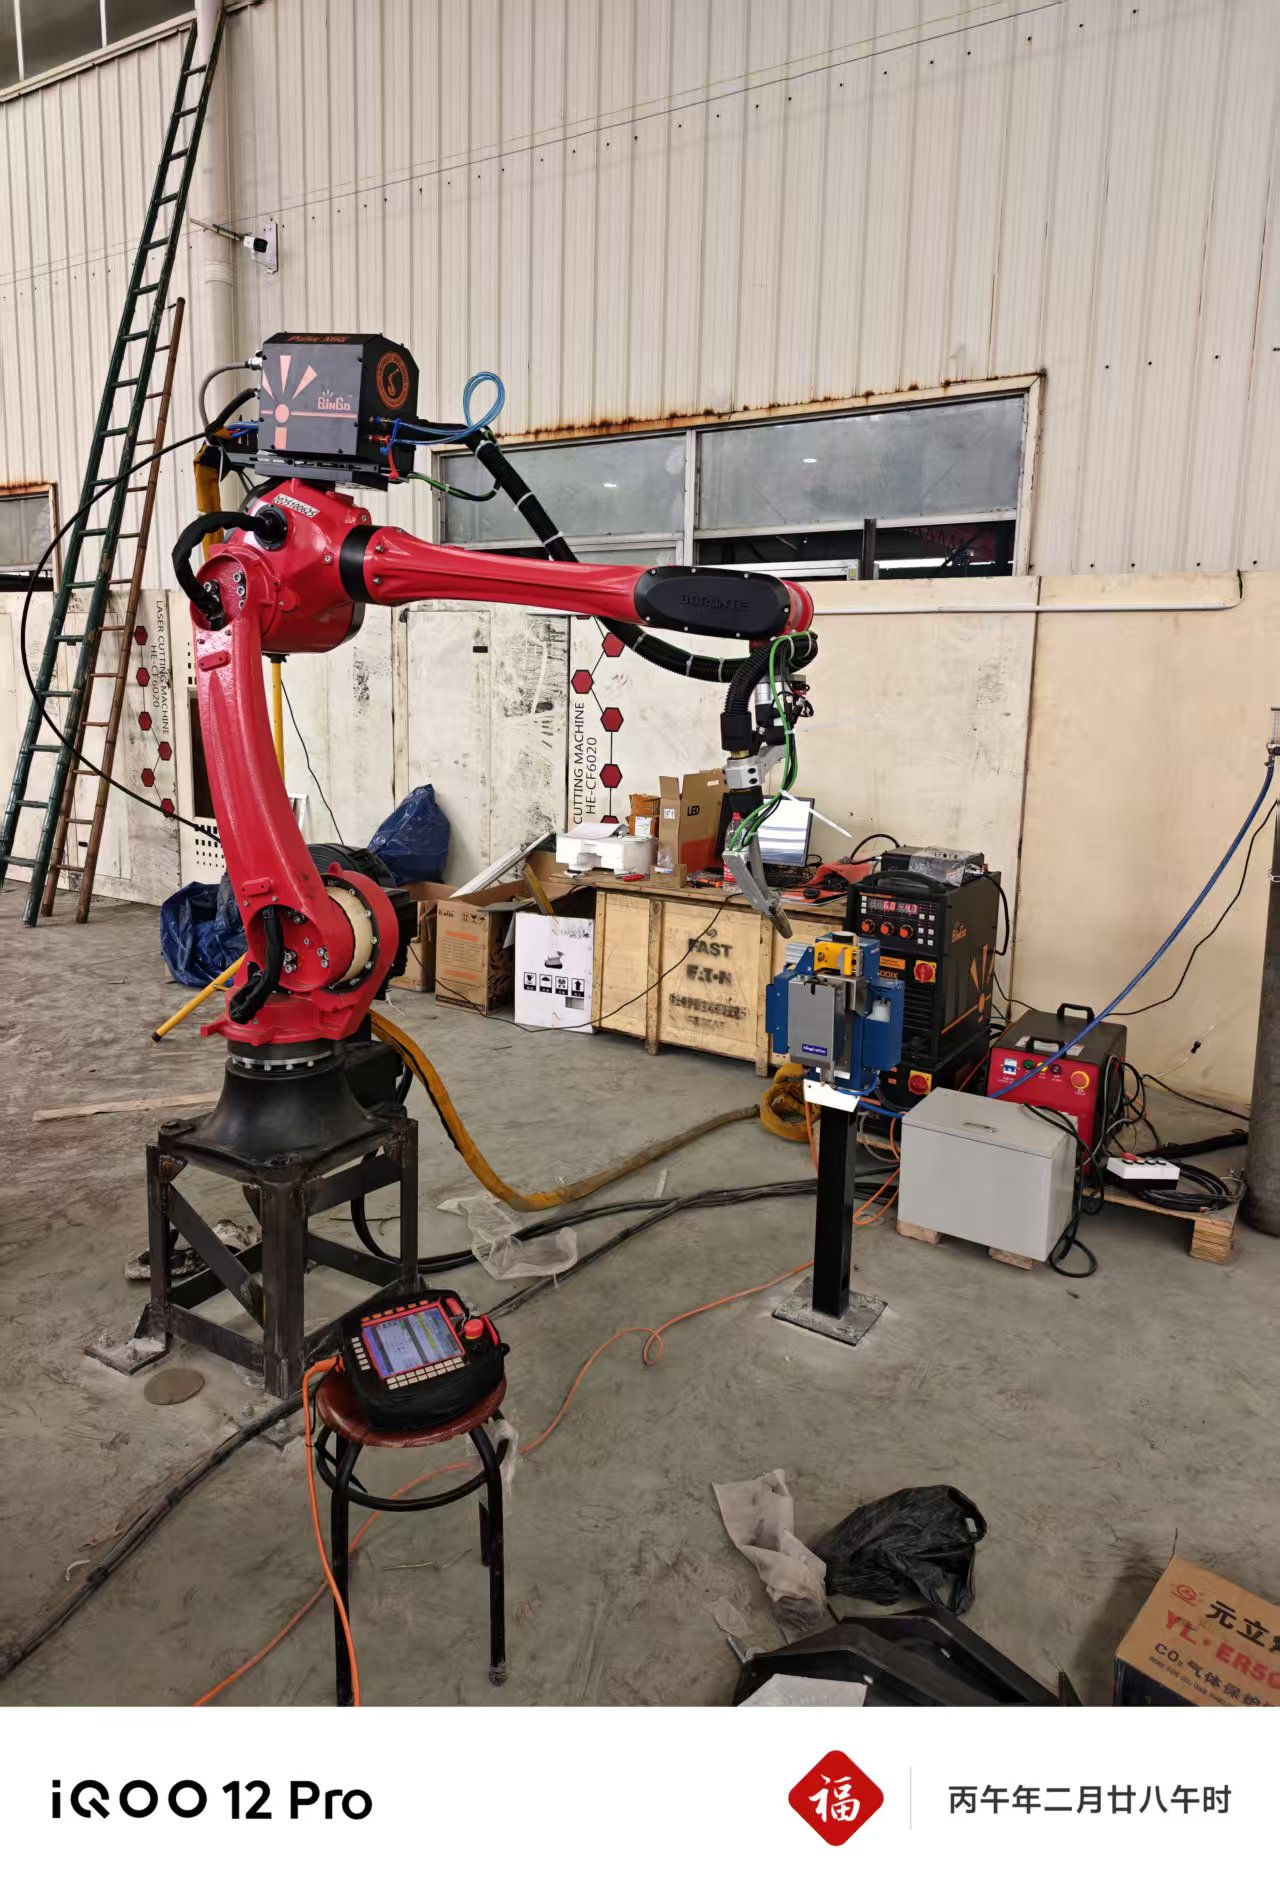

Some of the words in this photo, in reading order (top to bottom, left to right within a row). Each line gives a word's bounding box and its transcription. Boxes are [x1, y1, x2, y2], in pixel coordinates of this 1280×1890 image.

[274, 496, 317, 518] 2025100625
[156, 600, 165, 633] LASER
[150, 645, 160, 708] HE-CF6020
[157, 637, 168, 683] CUTTING
[159, 686, 170, 735] MACHINE
[573, 702, 585, 765] MACHINE
[573, 767, 584, 825] CUTTING
[585, 736, 598, 815] HE-CF6020
[687, 805, 700, 817] LED
[688, 938, 733, 959] FAST
